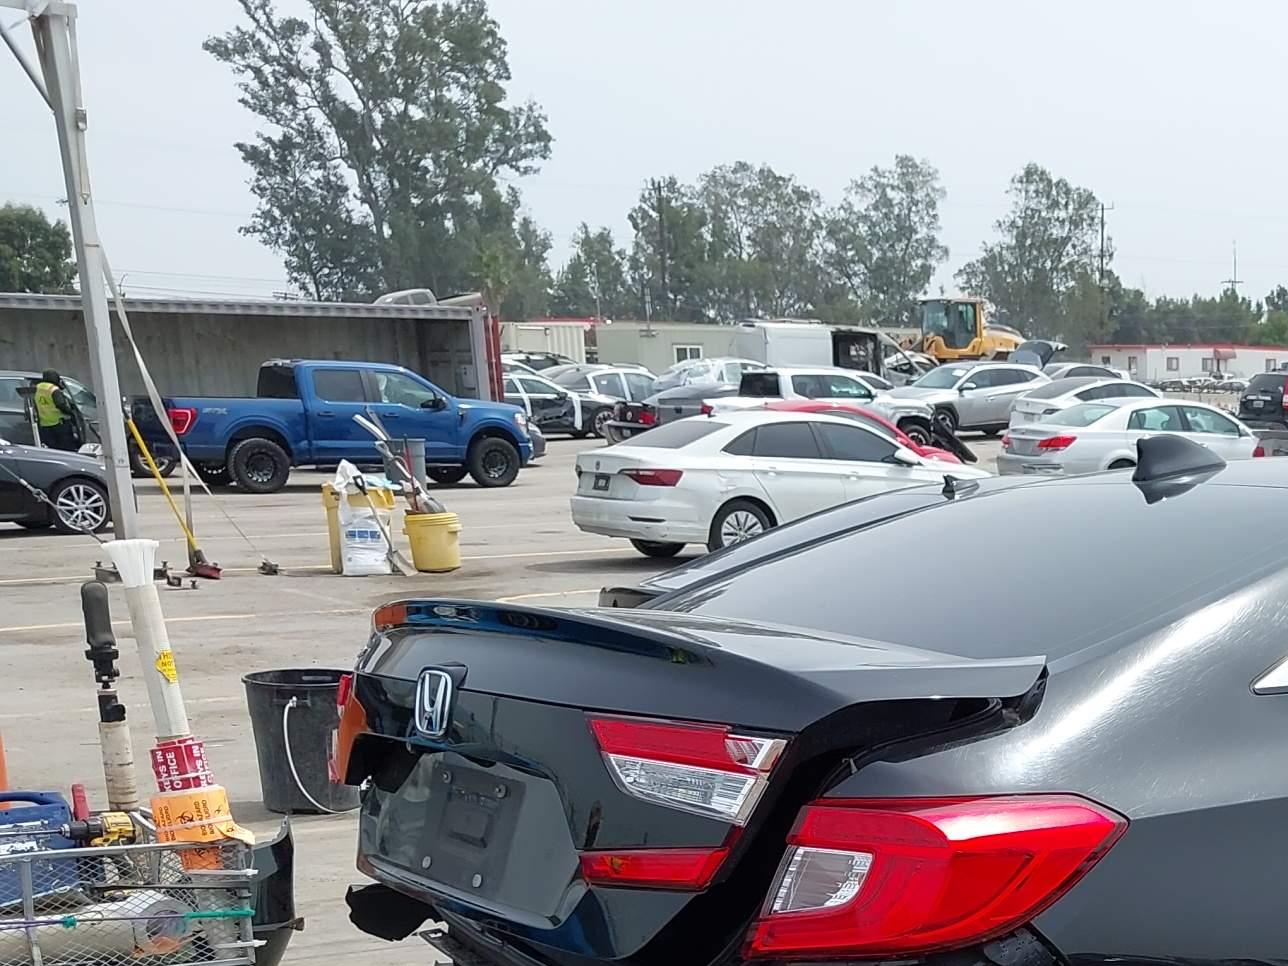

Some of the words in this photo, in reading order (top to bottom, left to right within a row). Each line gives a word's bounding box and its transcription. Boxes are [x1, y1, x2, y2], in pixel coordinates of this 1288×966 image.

[155, 750, 165, 763] IN
[191, 745, 201, 757] IN
[193, 801, 208, 836] BIOAZARD
